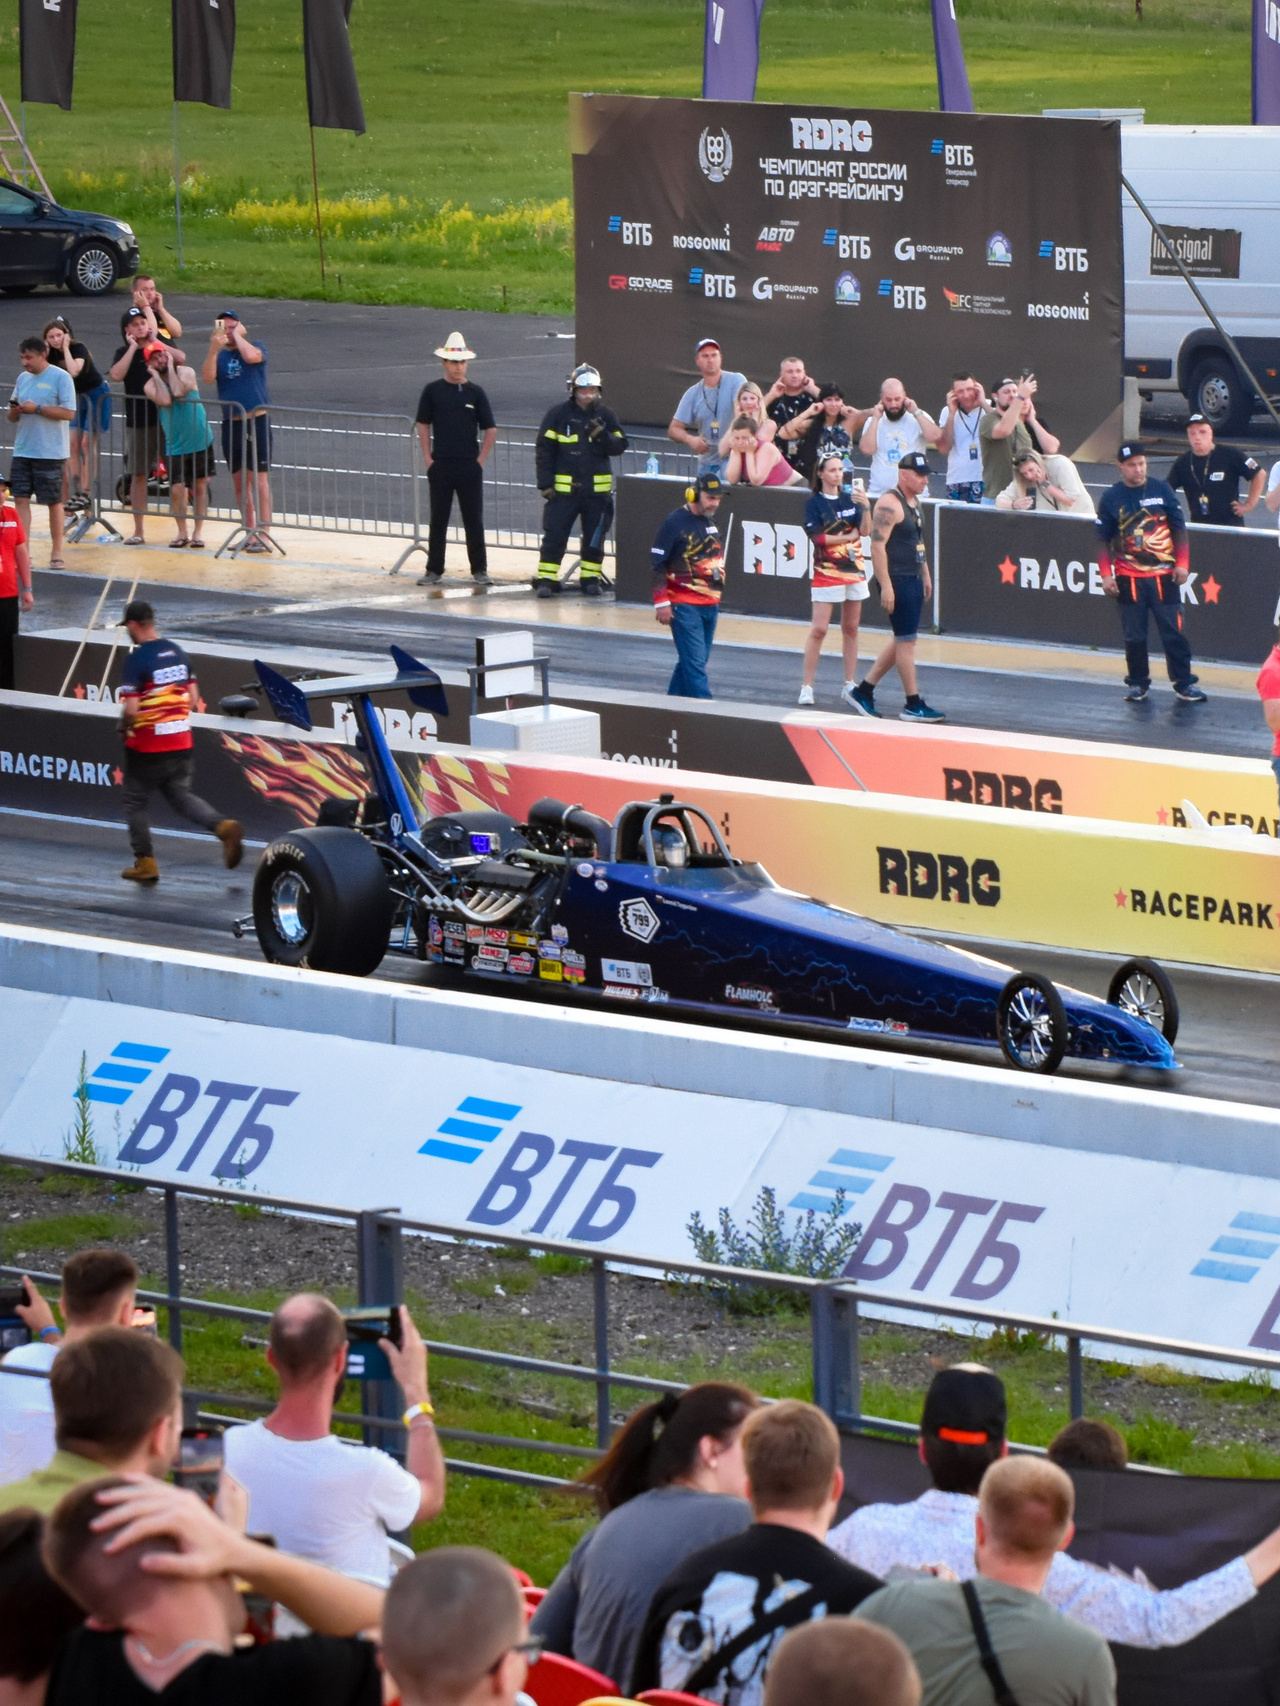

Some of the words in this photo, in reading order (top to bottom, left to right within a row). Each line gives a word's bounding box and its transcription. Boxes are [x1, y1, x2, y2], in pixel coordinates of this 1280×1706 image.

[790, 117, 873, 152] RDRC
[945, 145, 974, 166] ВТБ
[759, 158, 844, 178] ЧЕМПИОНАТ
[849, 163, 907, 181] РОССИИ
[764, 179, 784, 197] ПО
[788, 177, 904, 202] ДРЭГ-РЕЙСИНГУ
[622, 222, 653, 247] ВТБ
[673, 235, 731, 252] ROSGONKI
[758, 227, 795, 242] АВТО
[838, 235, 872, 260] ВТБ
[916, 245, 964, 256] GROUPAUTO
[1055, 246, 1089, 272] ВТБ
[1176, 233, 1213, 264] signal
[704, 274, 737, 299] ВТБ
[773, 284, 819, 295] GROUPAUTO
[893, 285, 927, 310] ВТБ
[1028, 303, 1090, 321] ROSGONKI
[0, 750, 112, 787] RACEPARK
[942, 767, 1063, 815] RDRC
[876, 846, 1001, 908] RDRC
[632, 912, 651, 928] 799
[1131, 889, 1275, 930] RACEPARK
[487, 928, 508, 940] MSD
[616, 967, 632, 979] ВТБ
[117, 1072, 300, 1179] ВТБ
[466, 1131, 664, 1243] ВТБ
[842, 1182, 1047, 1301] ВТБ
